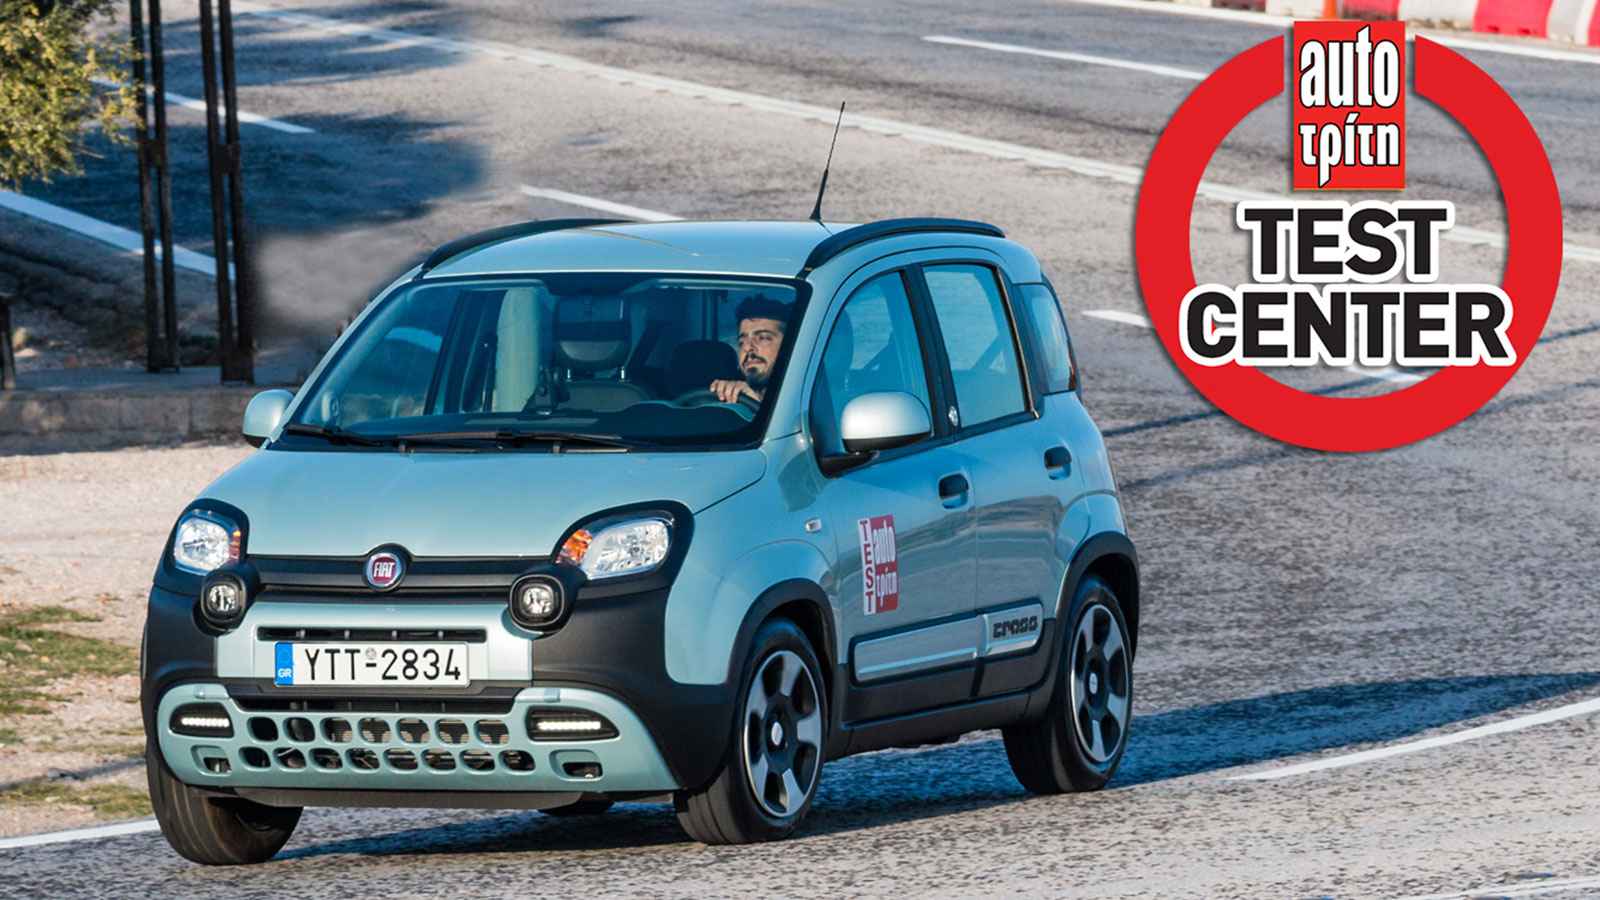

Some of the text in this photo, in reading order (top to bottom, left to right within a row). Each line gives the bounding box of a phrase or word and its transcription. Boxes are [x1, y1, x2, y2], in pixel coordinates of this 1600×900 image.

[873, 519, 896, 564] auto
[373, 561, 396, 578] FIAT
[859, 520, 874, 612] TEST
[277, 668, 292, 678] GR
